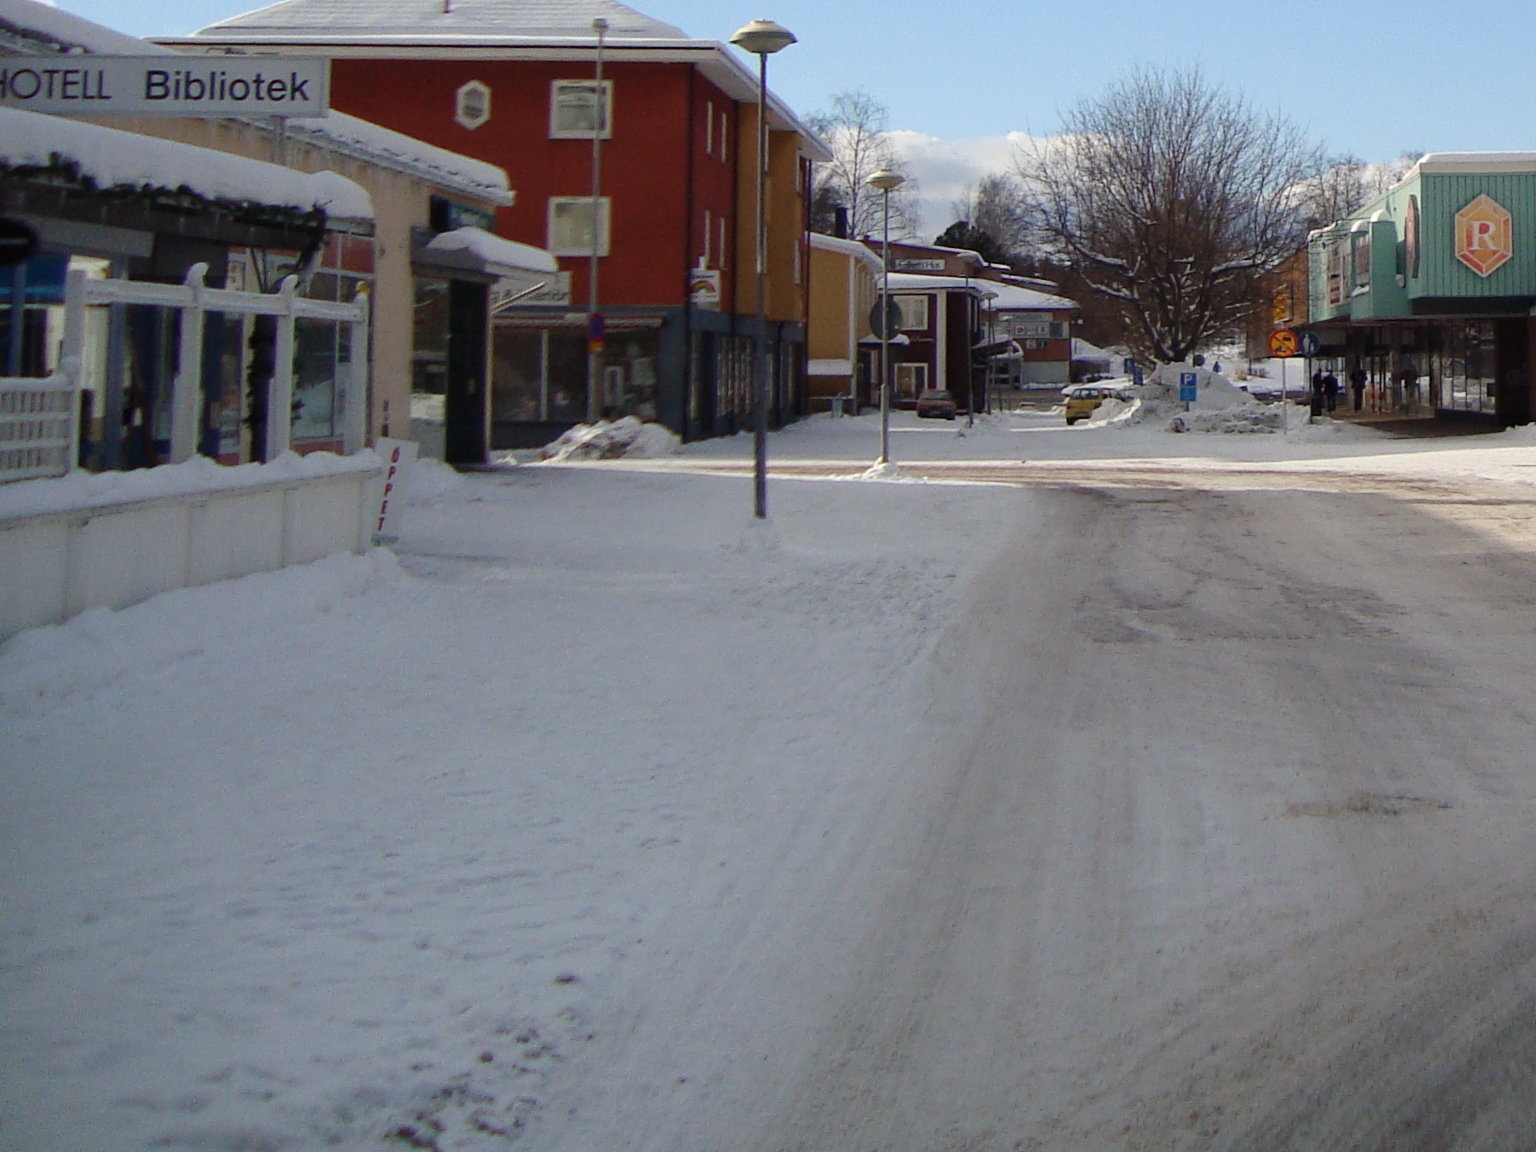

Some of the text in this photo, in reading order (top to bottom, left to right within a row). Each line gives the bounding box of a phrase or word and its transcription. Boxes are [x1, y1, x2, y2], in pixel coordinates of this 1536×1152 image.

[145, 70, 311, 101] Bibliotek
[1470, 221, 1500, 250] R
[1184, 374, 1193, 386] P
